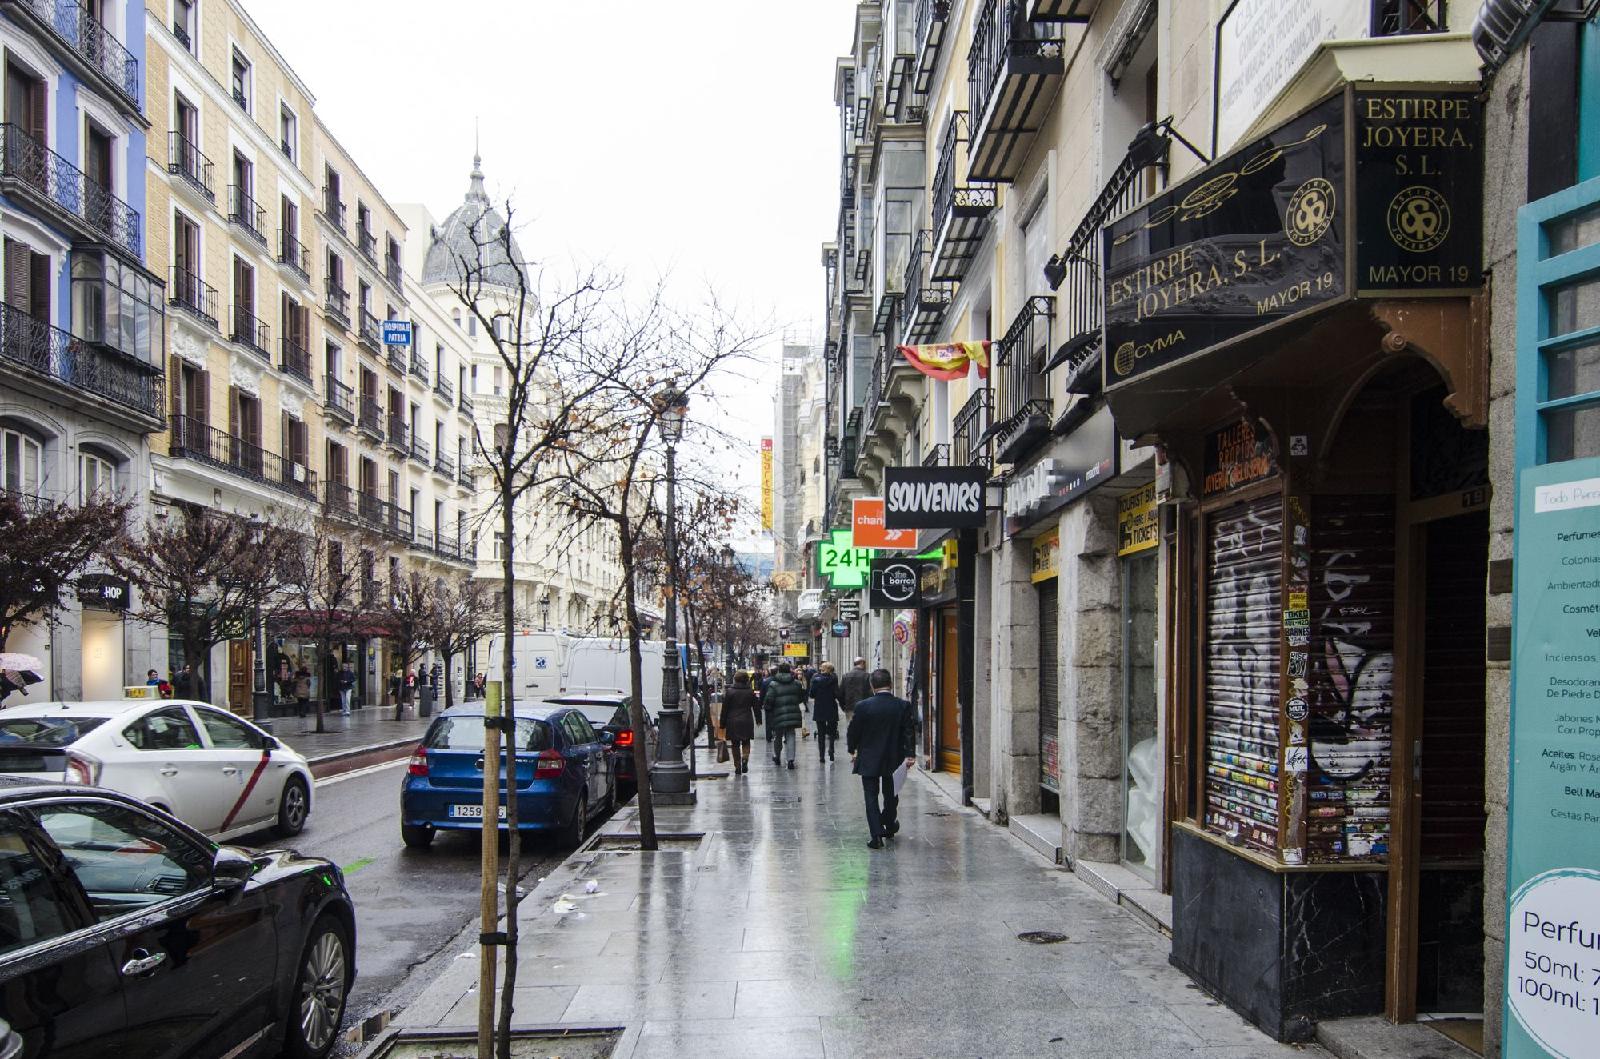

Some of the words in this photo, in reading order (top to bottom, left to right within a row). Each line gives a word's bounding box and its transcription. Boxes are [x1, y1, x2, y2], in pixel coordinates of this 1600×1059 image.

[1366, 98, 1471, 119] ESTIRPE
[1363, 126, 1473, 150] JOYERA,
[1395, 154, 1414, 175] S.
[1421, 155, 1442, 175] L.
[1259, 238, 1281, 267] L.
[1110, 245, 1195, 307] ESTIRPE
[1369, 265, 1441, 283] MAYOR
[1448, 265, 1469, 283] 19
[1257, 280, 1311, 316] MAYOR
[1315, 272, 1333, 292] 19
[388, 333, 407, 342] PATRIA
[1134, 329, 1187, 360] CYMA
[888, 481, 980, 513] SOUVENIRS
[857, 515, 882, 526] chan
[1133, 522, 1158, 546] TICKETS
[826, 549, 869, 567] 24H
[102, 586, 122, 599] HOP
[1562, 604, 1600, 614] Cosmét
[1546, 688, 1559, 698] De
[1561, 688, 1591, 699] Piedra
[1557, 725, 1576, 734] Con
[1541, 748, 1575, 759] Aceites
[1564, 786, 1583, 796] Bell
[457, 806, 482, 817] 1259
[1550, 808, 1582, 820] Cestas
[1524, 911, 1600, 949] Perfu
[1524, 951, 1584, 983] 50ml:
[1518, 976, 1585, 1012] 100ml:
